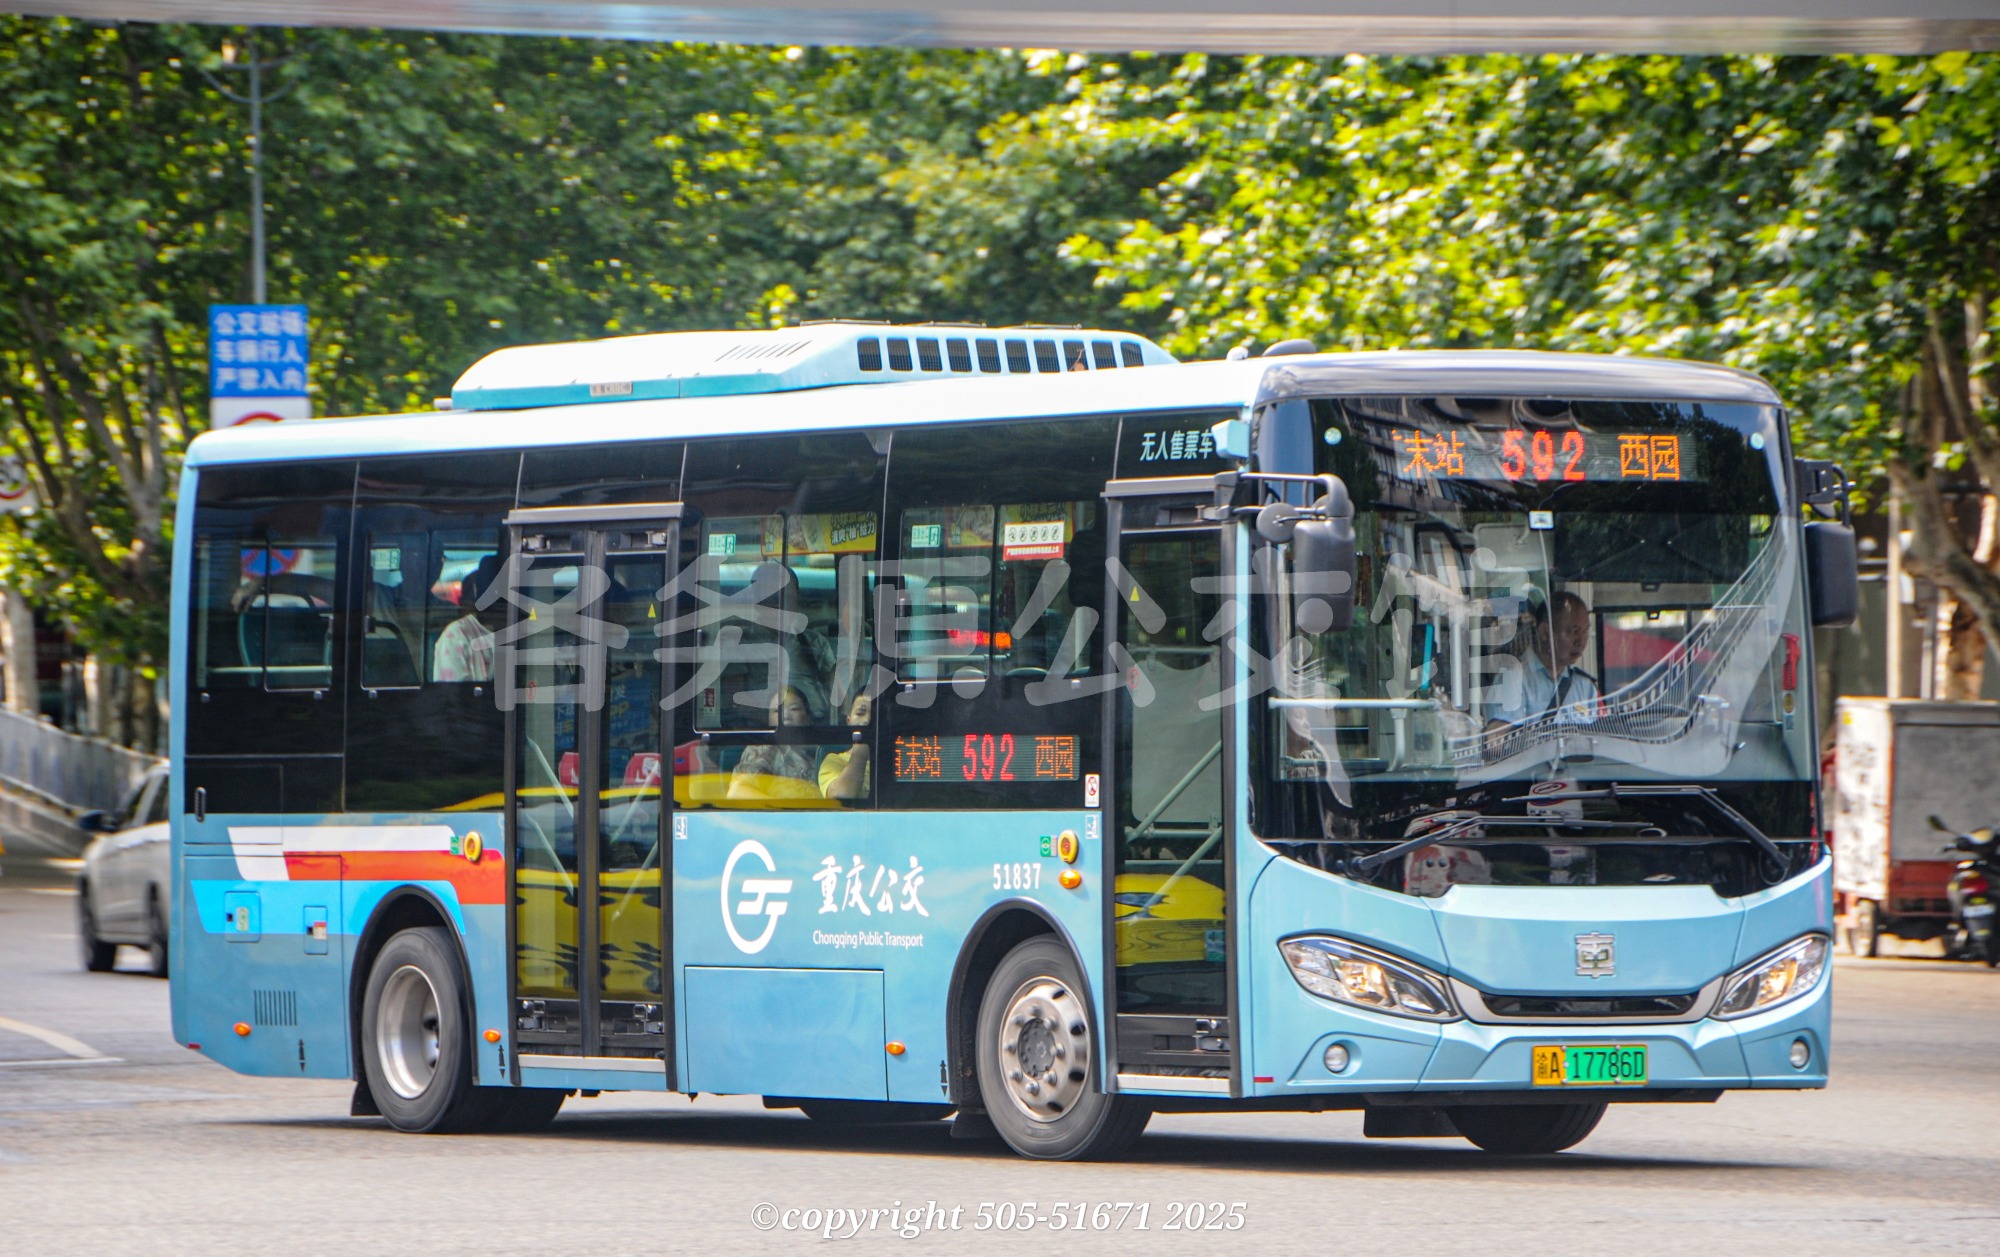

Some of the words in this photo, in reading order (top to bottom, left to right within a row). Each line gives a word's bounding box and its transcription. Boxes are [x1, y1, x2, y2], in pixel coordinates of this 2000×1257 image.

[1140, 428, 1213, 461] 无人售票车
[1392, 430, 1465, 478] 末站
[1502, 429, 1586, 481] 592
[1618, 435, 1680, 480] 西园
[963, 734, 1014, 780] 592
[1035, 736, 1074, 779] 西园
[812, 854, 929, 917] 重庆公交
[993, 862, 1041, 890] 51837
[812, 930, 858, 949] Chongqing
[859, 931, 884, 946] Public
[884, 932, 924, 950] Transport
